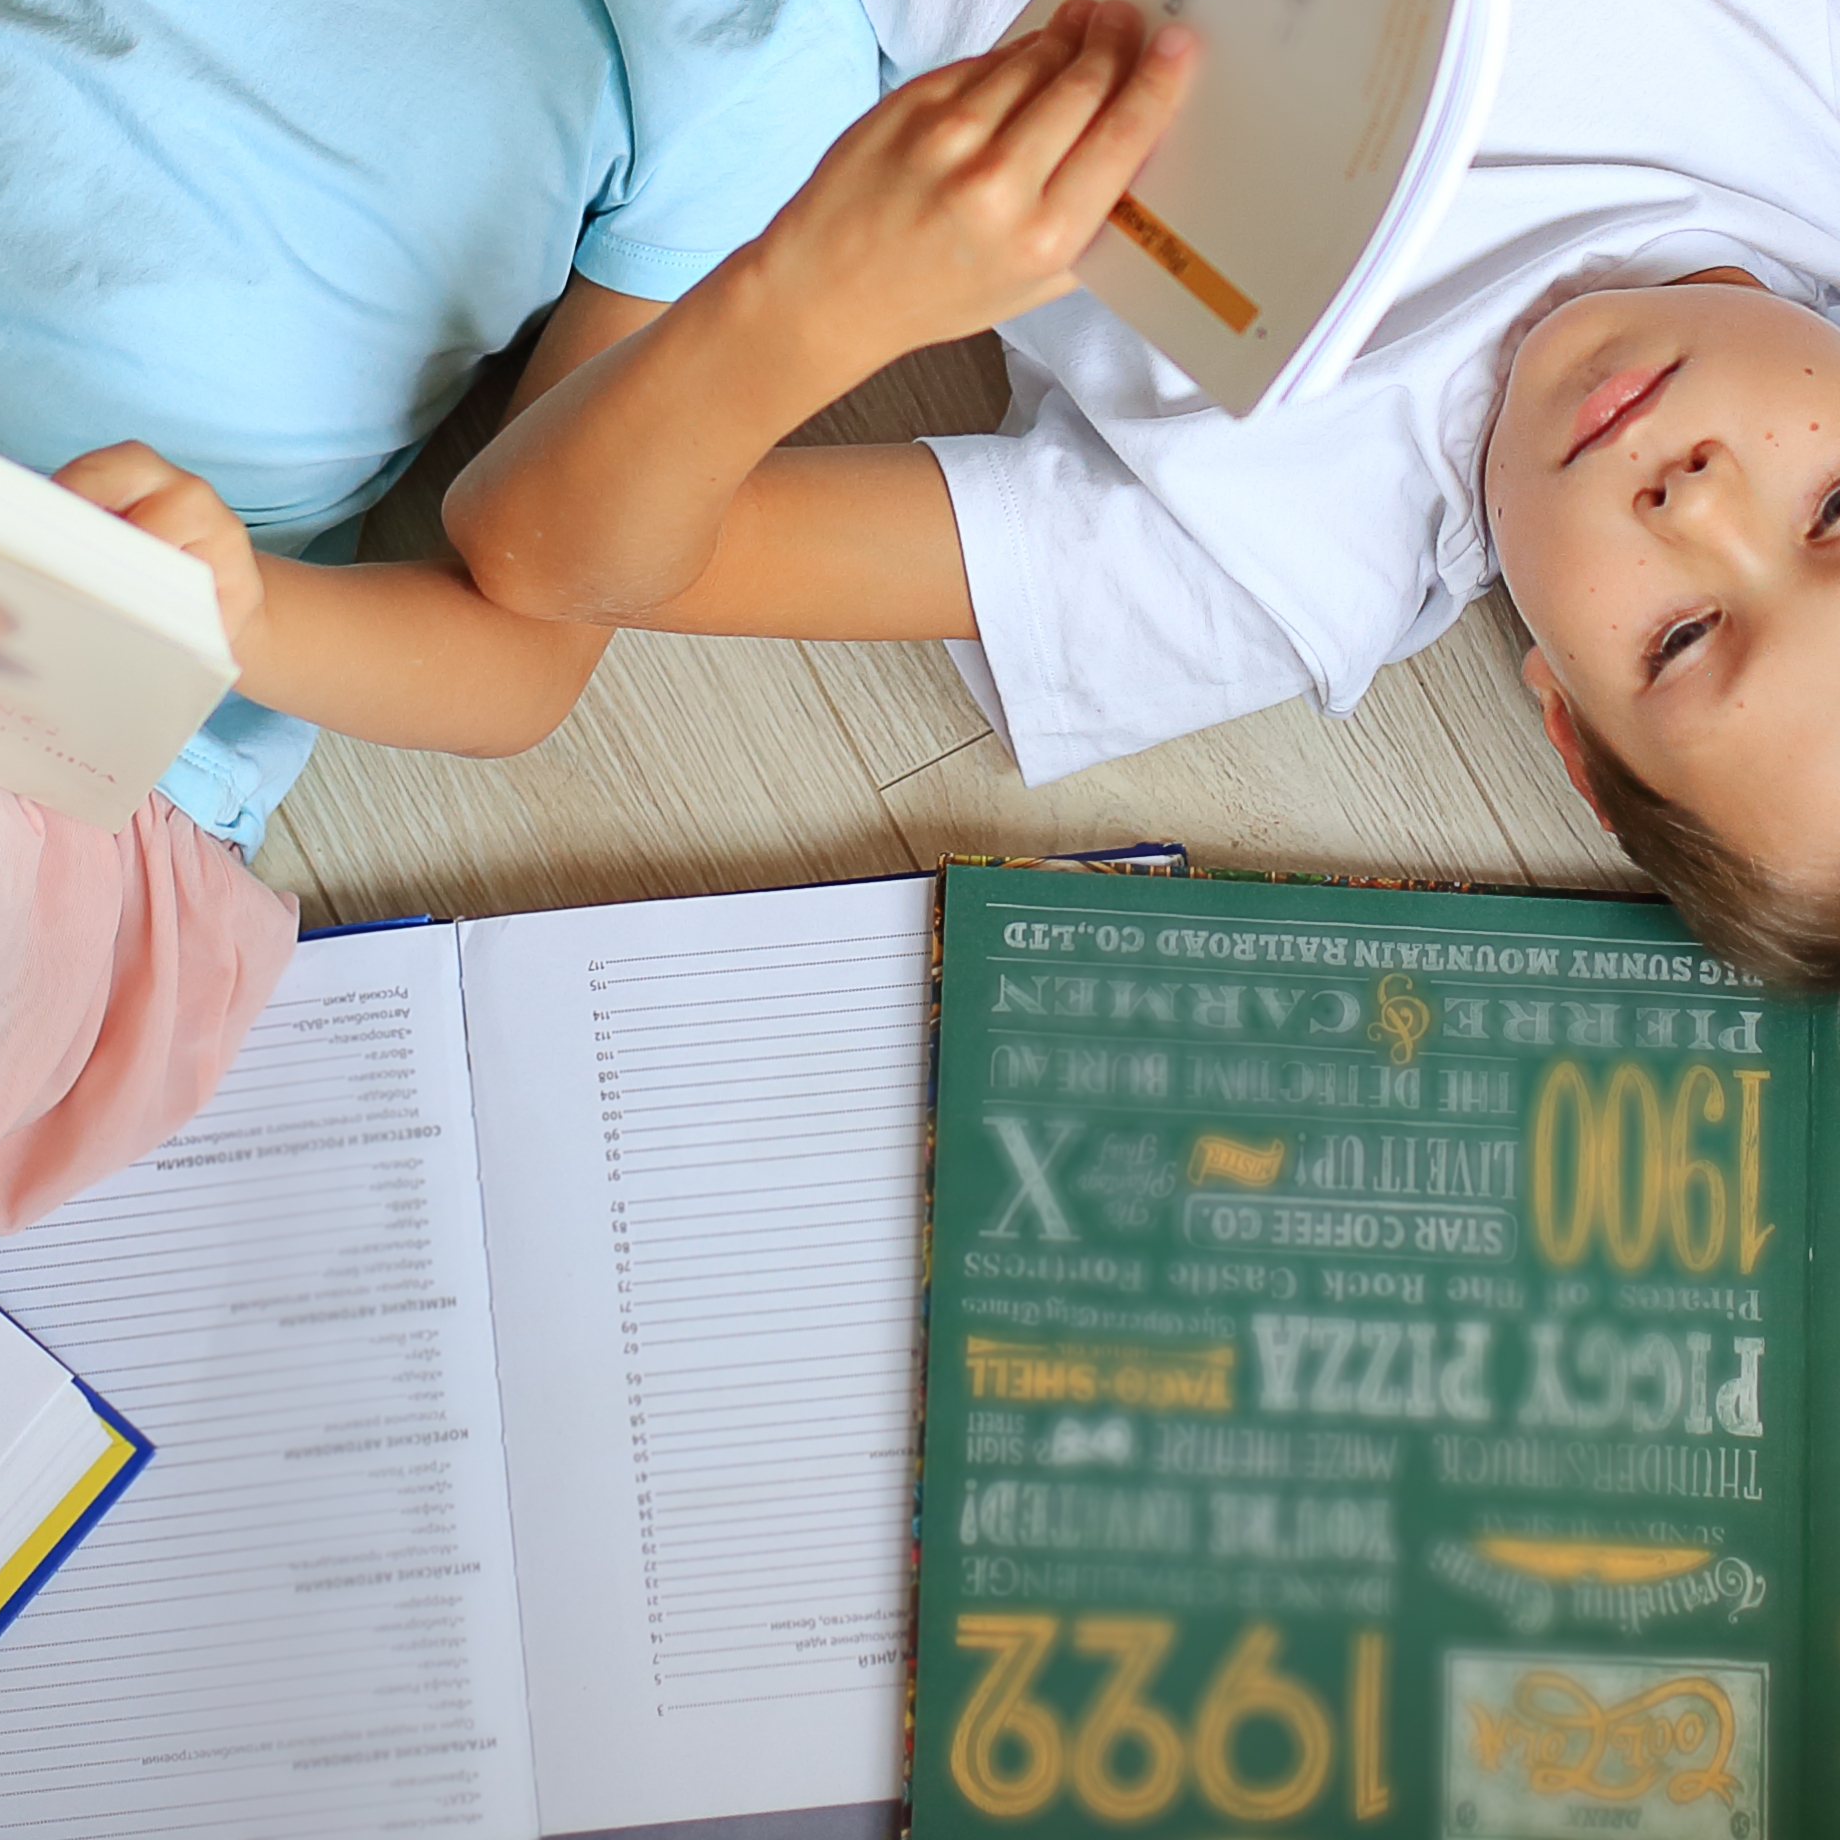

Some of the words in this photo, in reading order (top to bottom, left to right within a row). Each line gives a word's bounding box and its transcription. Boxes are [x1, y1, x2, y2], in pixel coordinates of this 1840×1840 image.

[588, 959, 606, 972] 117
[1156, 928, 1349, 965] RAILROAD
[1353, 936, 1560, 978] MOUNTAIN
[1568, 948, 1693, 983] SUNNY
[322, 990, 356, 1006] джип
[359, 986, 408, 1003] Русский
[590, 979, 608, 991] 115
[990, 971, 1361, 1035] CARMEN
[332, 1007, 410, 1026] Автомобили
[593, 1009, 611, 1022] 114
[1367, 972, 1431, 1065] &
[1441, 995, 1764, 1055] PIERRE
[989, 1043, 1167, 1099] BUREAU
[1183, 1056, 1420, 1111] DETECTIVE
[1437, 1069, 1517, 1114] THE
[979, 1116, 1087, 1242] X
[1294, 1132, 1365, 1190] UP!
[1532, 1062, 1775, 1277] 1900
[1201, 1206, 1260, 1241] CO.
[1272, 1208, 1404, 1249] COFFEE
[1415, 1217, 1503, 1255] STAR
[962, 1254, 1142, 1291] Fortress
[1167, 1260, 1297, 1303] Castle
[1320, 1267, 1426, 1306] Rock
[1445, 1274, 1523, 1310] The
[1619, 1285, 1762, 1321] Pirates
[1251, 1313, 1492, 1422] PIZZA
[1517, 1324, 1764, 1438] PIGGY
[967, 1412, 1025, 1433] STREET
[967, 1436, 1024, 1464] SIGN
[1431, 1435, 1762, 1500] THUNDERSTRUCK
[952, 1615, 1390, 1822] 1922
